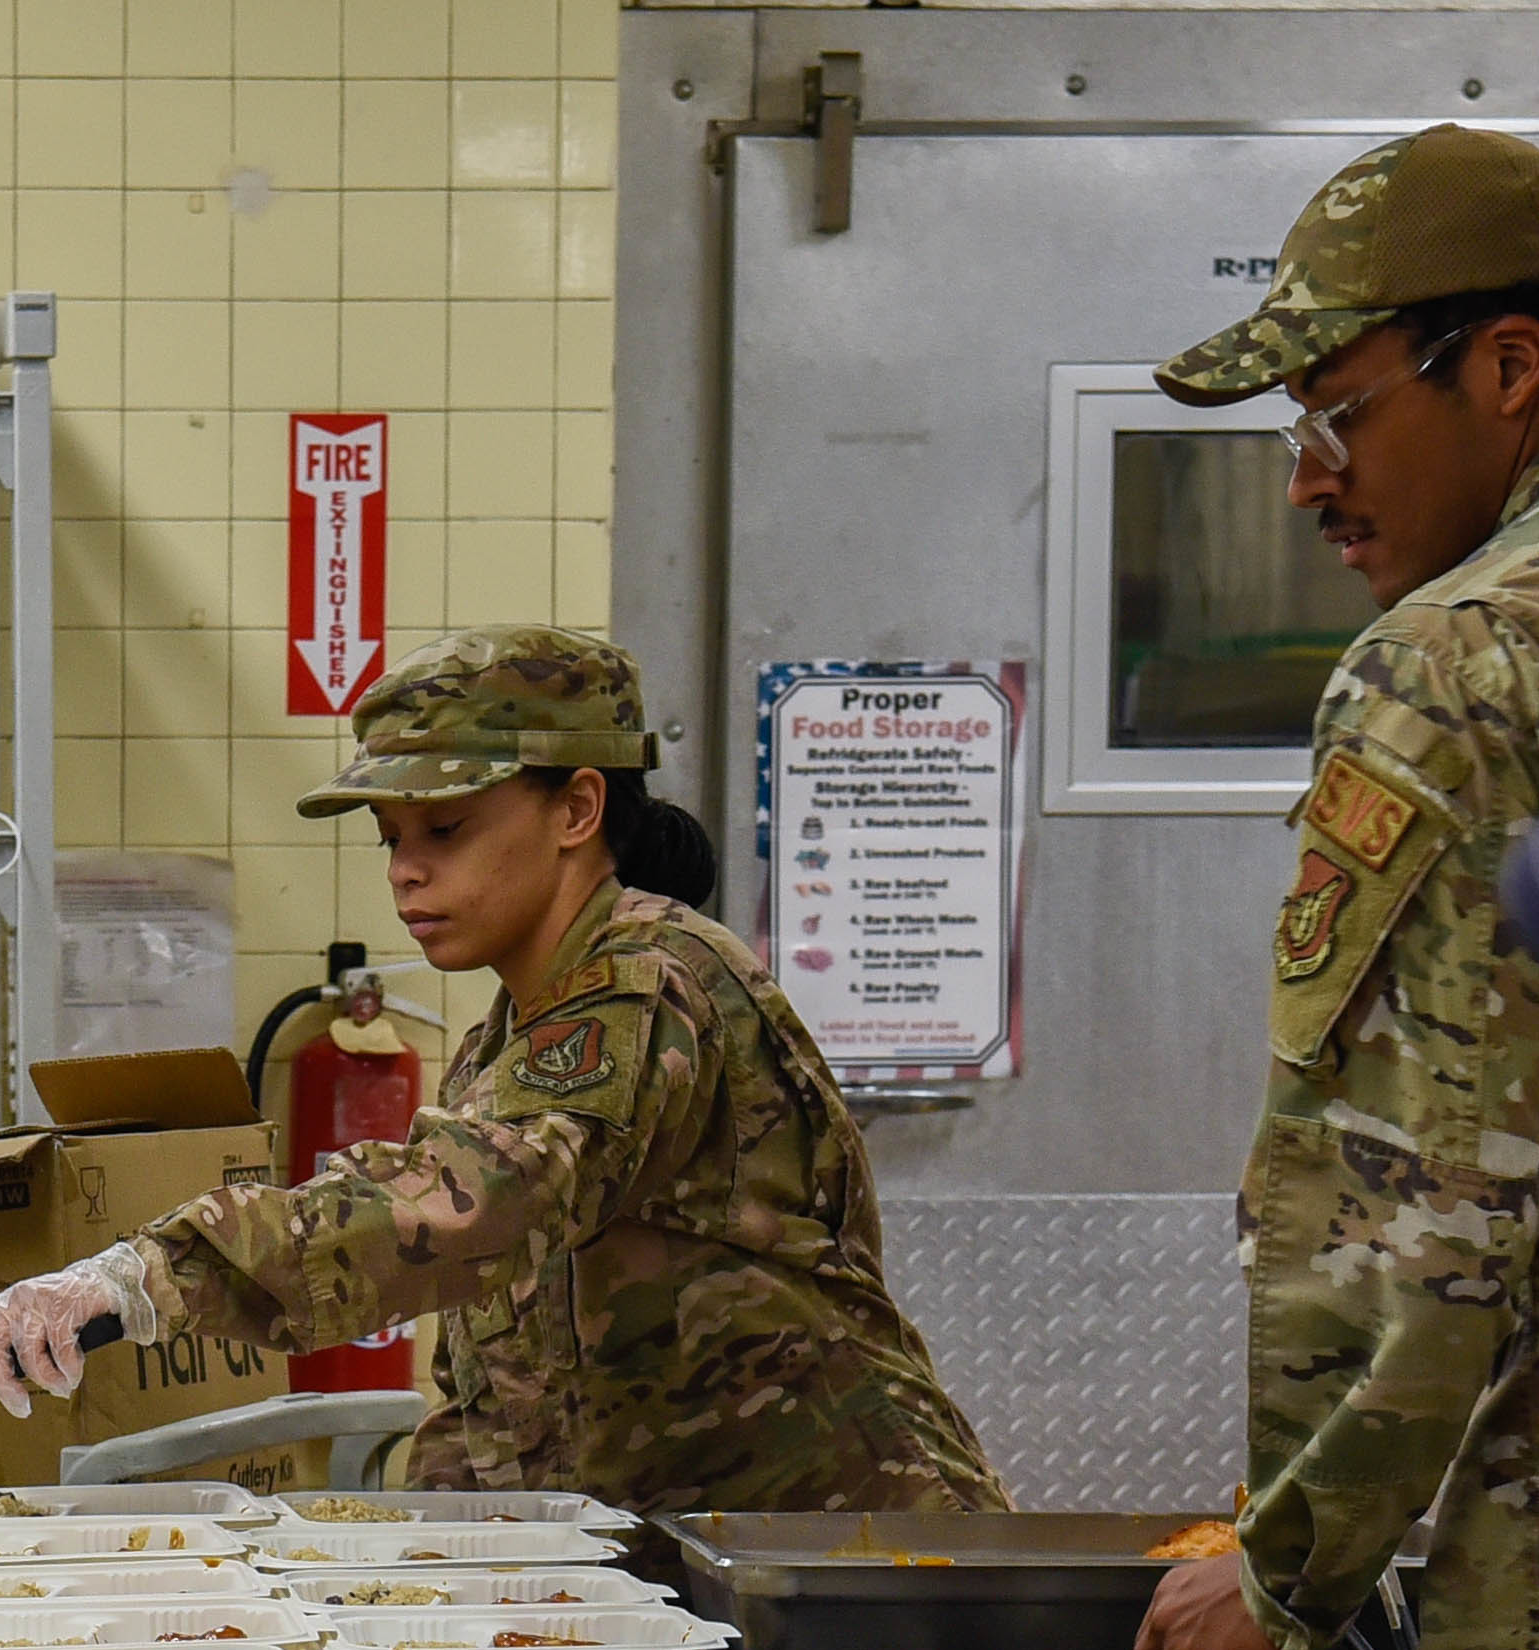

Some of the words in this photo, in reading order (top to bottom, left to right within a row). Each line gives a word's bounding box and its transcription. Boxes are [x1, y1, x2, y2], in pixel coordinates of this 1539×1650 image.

[306, 443, 372, 482] FIRE
[328, 490, 348, 689] EXTINGUISHER
[841, 688, 943, 715] Proper
[792, 715, 863, 740] Food
[872, 715, 992, 744] Storage
[912, 747, 962, 761] Safely
[900, 765, 924, 775] and
[927, 764, 954, 774] Raw
[958, 764, 996, 775] Foods
[815, 781, 878, 796] Storage
[882, 781, 958, 795] Hierarchy
[1313, 763, 1402, 857] SVS
[864, 878, 891, 889] Raw
[895, 878, 949, 889] Seafood
[864, 914, 891, 925] Raw
[895, 914, 935, 924] Whole
[938, 914, 978, 924] Meats
[864, 948, 891, 959] Raw
[895, 948, 941, 959] Ground
[944, 948, 983, 959] Meats
[864, 983, 891, 993] Raw
[895, 982, 940, 995] Poultry
[228, 1460, 277, 1494] Cutlery
